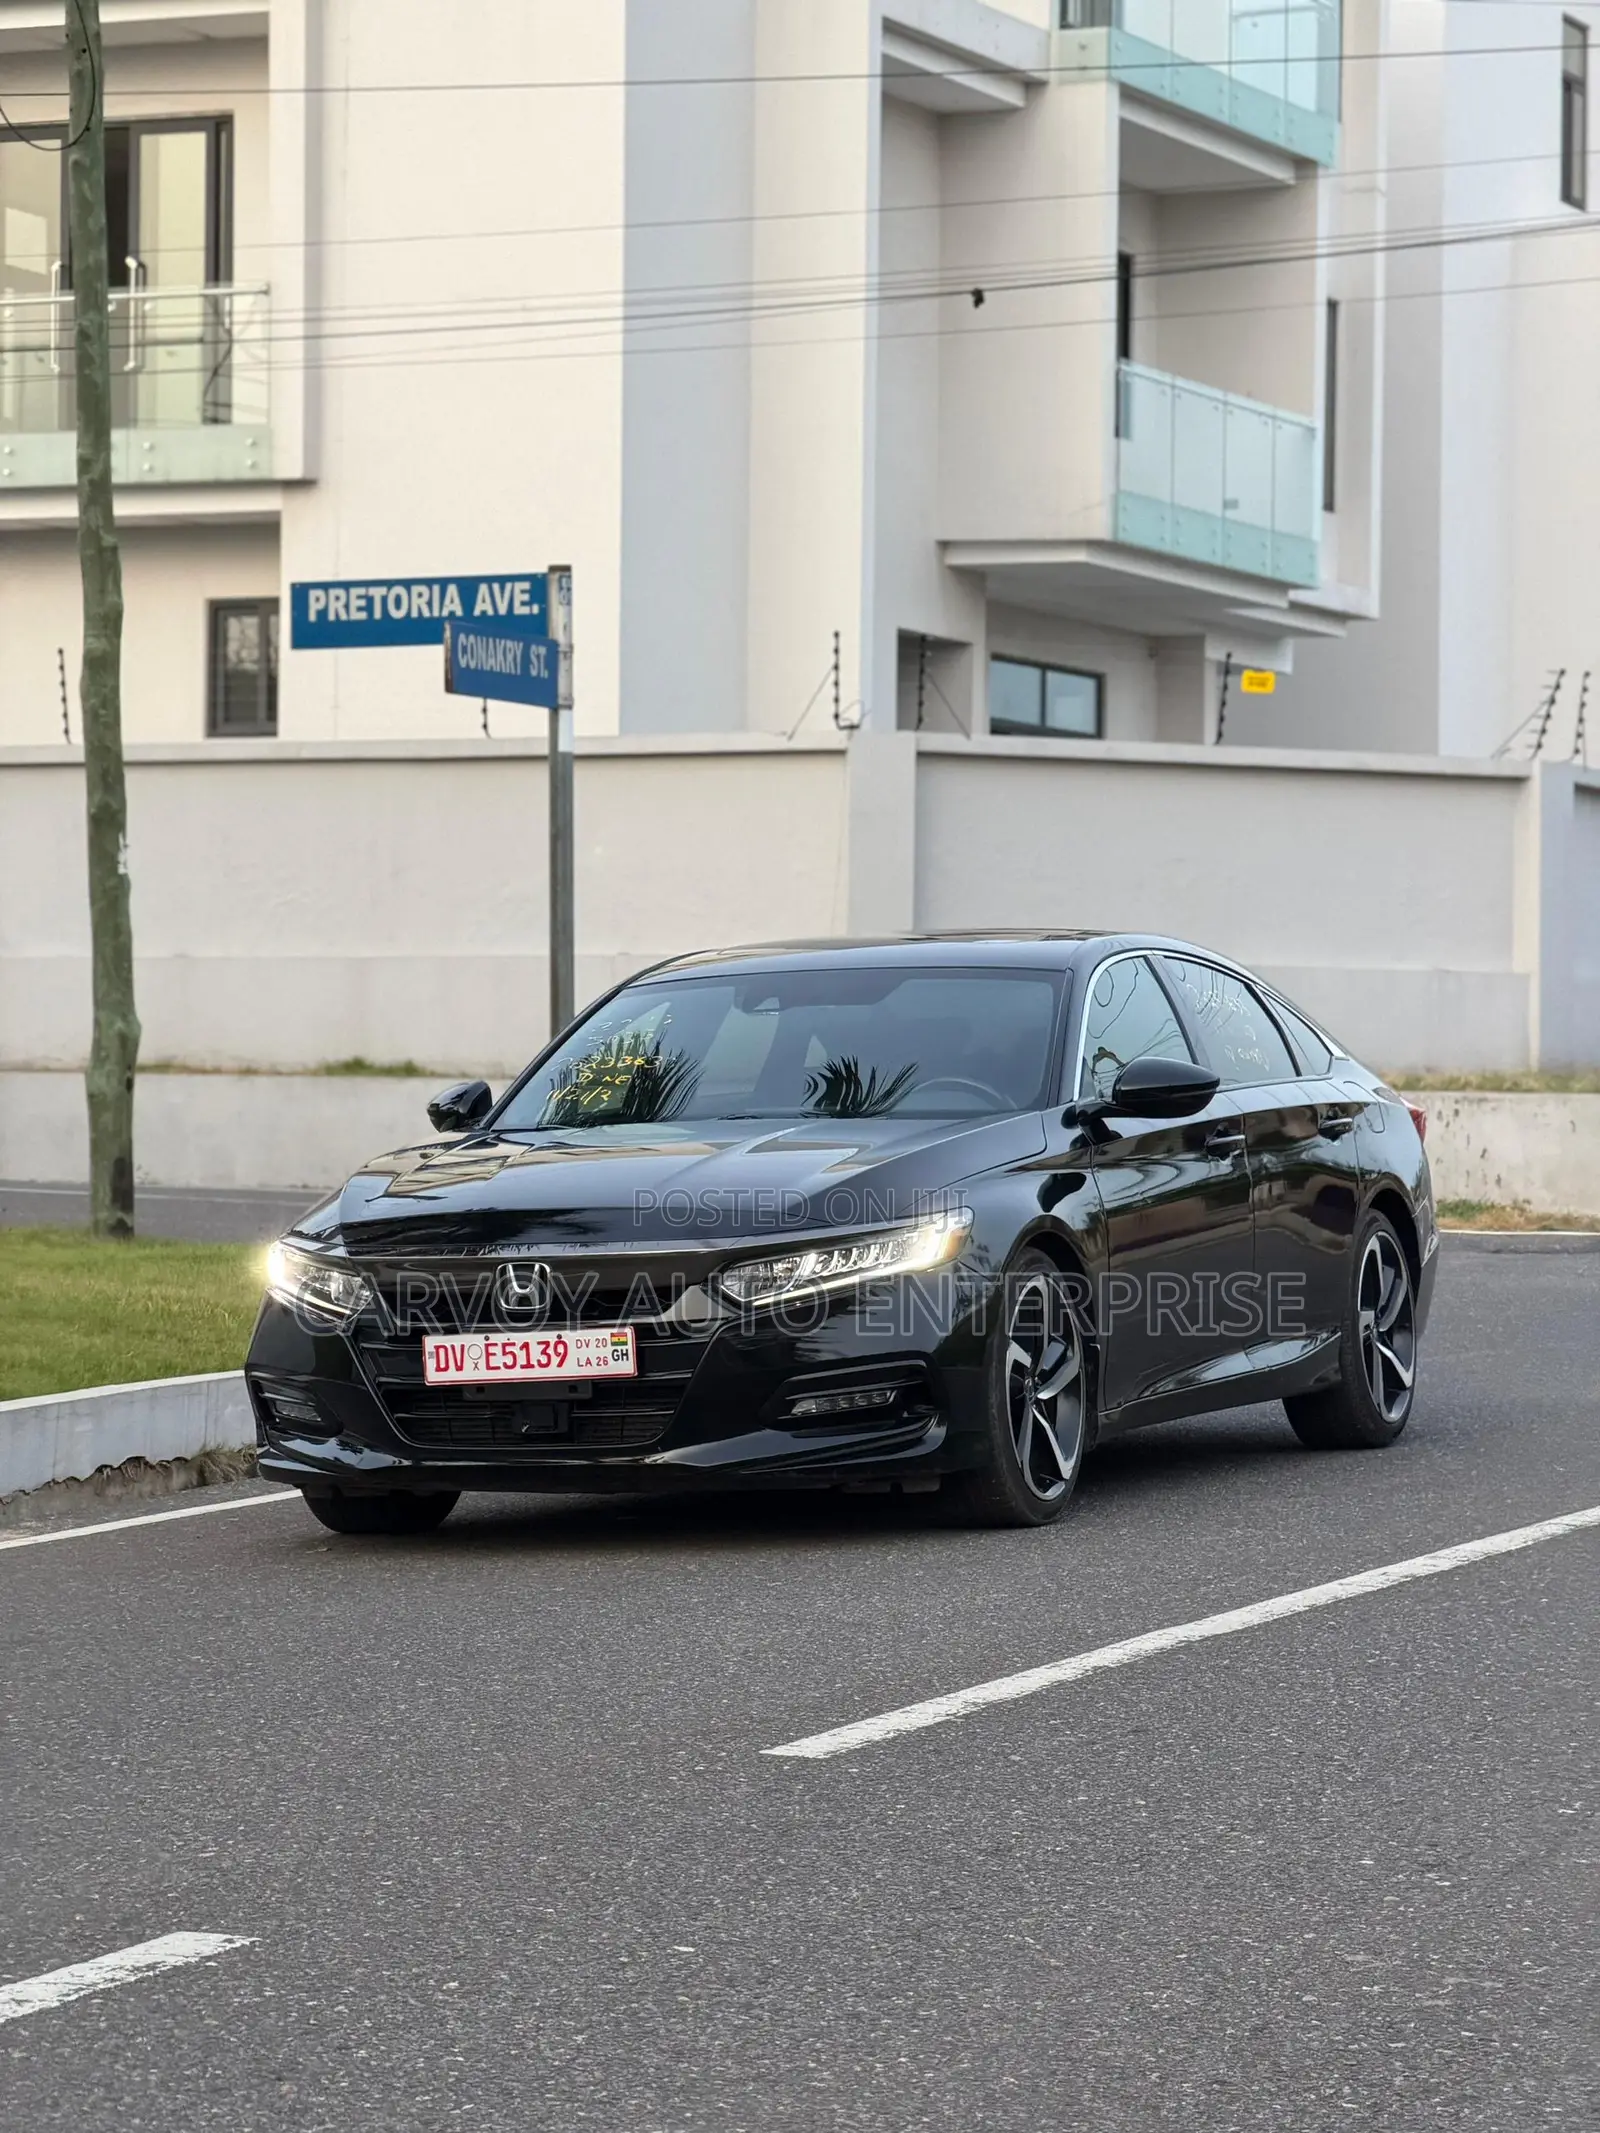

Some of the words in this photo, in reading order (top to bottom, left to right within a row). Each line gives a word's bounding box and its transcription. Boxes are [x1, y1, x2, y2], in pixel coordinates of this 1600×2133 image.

[308, 584, 463, 622] PRETORIA
[473, 581, 540, 617] AVE.
[457, 633, 523, 676] CONAKRY
[529, 645, 549, 679] ST.
[575, 1338, 591, 1349] DV
[595, 1337, 607, 1348] 20
[434, 1344, 465, 1372] DV
[484, 1340, 568, 1370] E5139
[577, 1356, 592, 1367] LA
[596, 1356, 608, 1367] 26
[611, 1348, 629, 1361] GH
